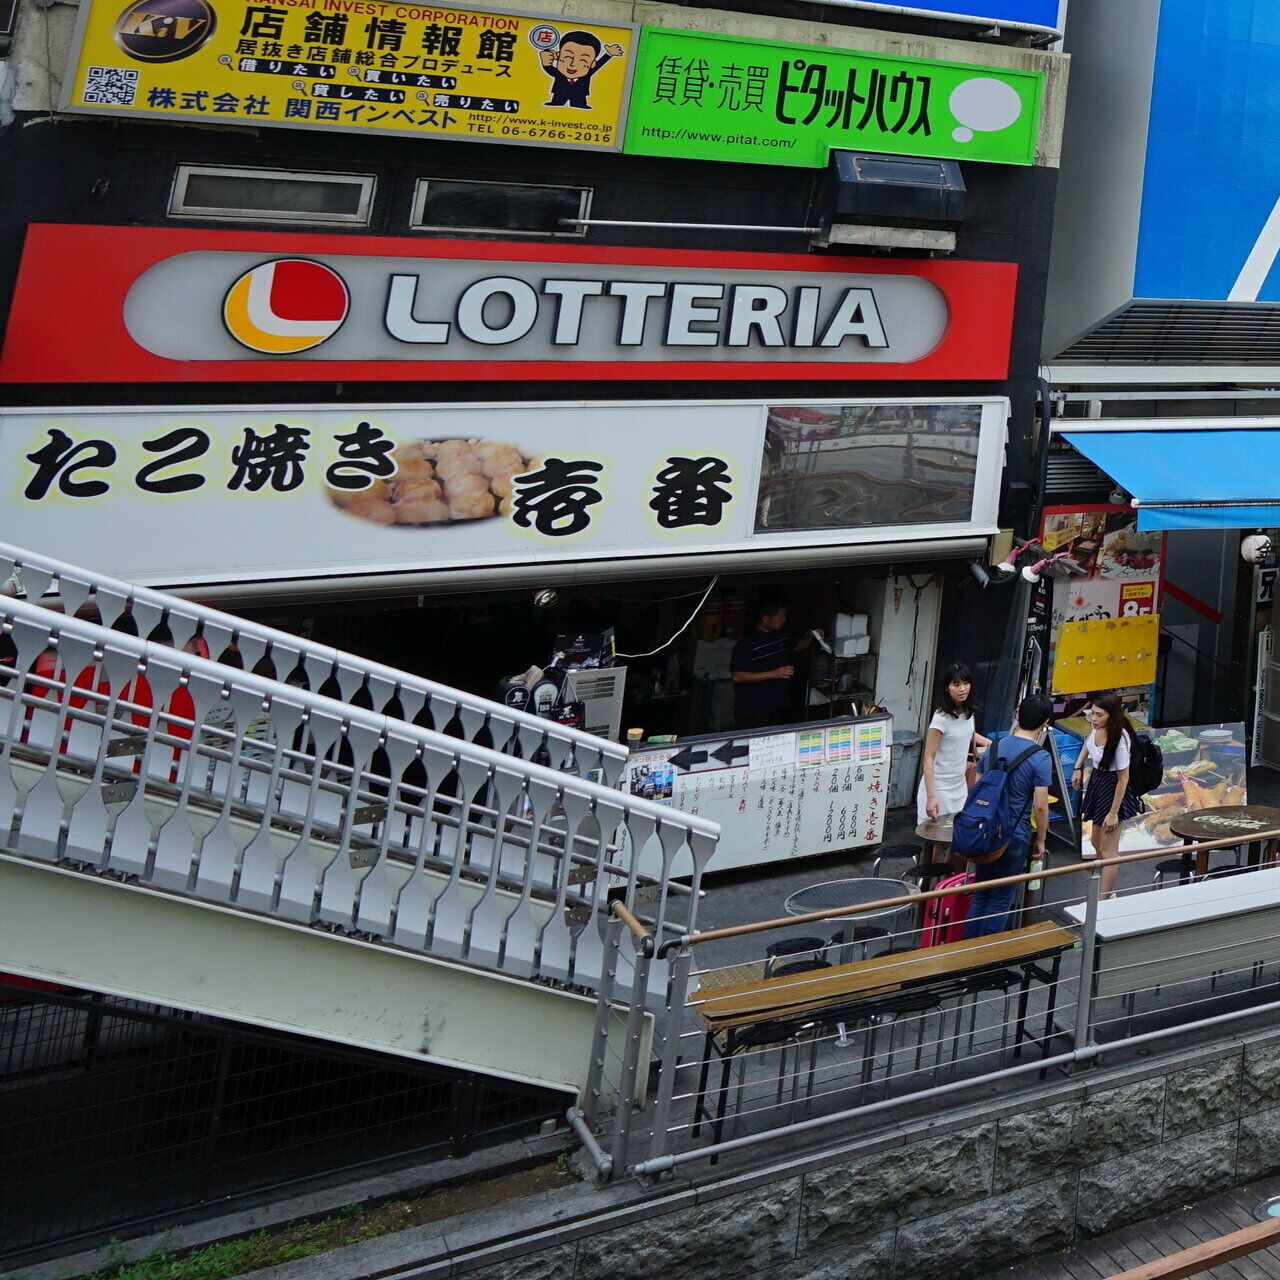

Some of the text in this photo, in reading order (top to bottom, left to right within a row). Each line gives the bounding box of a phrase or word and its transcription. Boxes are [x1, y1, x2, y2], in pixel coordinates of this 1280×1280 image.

[240, 4, 518, 63] 店舗情報館
[395, 6, 520, 31] CORPORATION
[535, 26, 554, 44] 店
[234, 38, 513, 79] 居抜き店舗総合プロデュース
[239, 58, 336, 78] 借りたい
[312, 83, 405, 103] 貸したい
[364, 69, 457, 89] 買いたい
[655, 54, 770, 114] 賃貸・売買
[147, 85, 457, 129] 株式会社 関西インベスト
[432, 93, 519, 113] 売りたい
[774, 58, 932, 138] ピタットハウス
[467, 121, 611, 143] TEL 06-6766-2016
[468, 112, 613, 132] http://www.k-invest.co.jp
[641, 125, 798, 150] http://www.pitat.com/
[383, 273, 890, 350] LOTTERIA
[26, 422, 734, 537] たこ焼き 壱番
[866, 761, 883, 841] こ焼き壱番
[823, 801, 834, 843] 1200円
[837, 806, 847, 840] 600円
[849, 803, 858, 838] 360円
